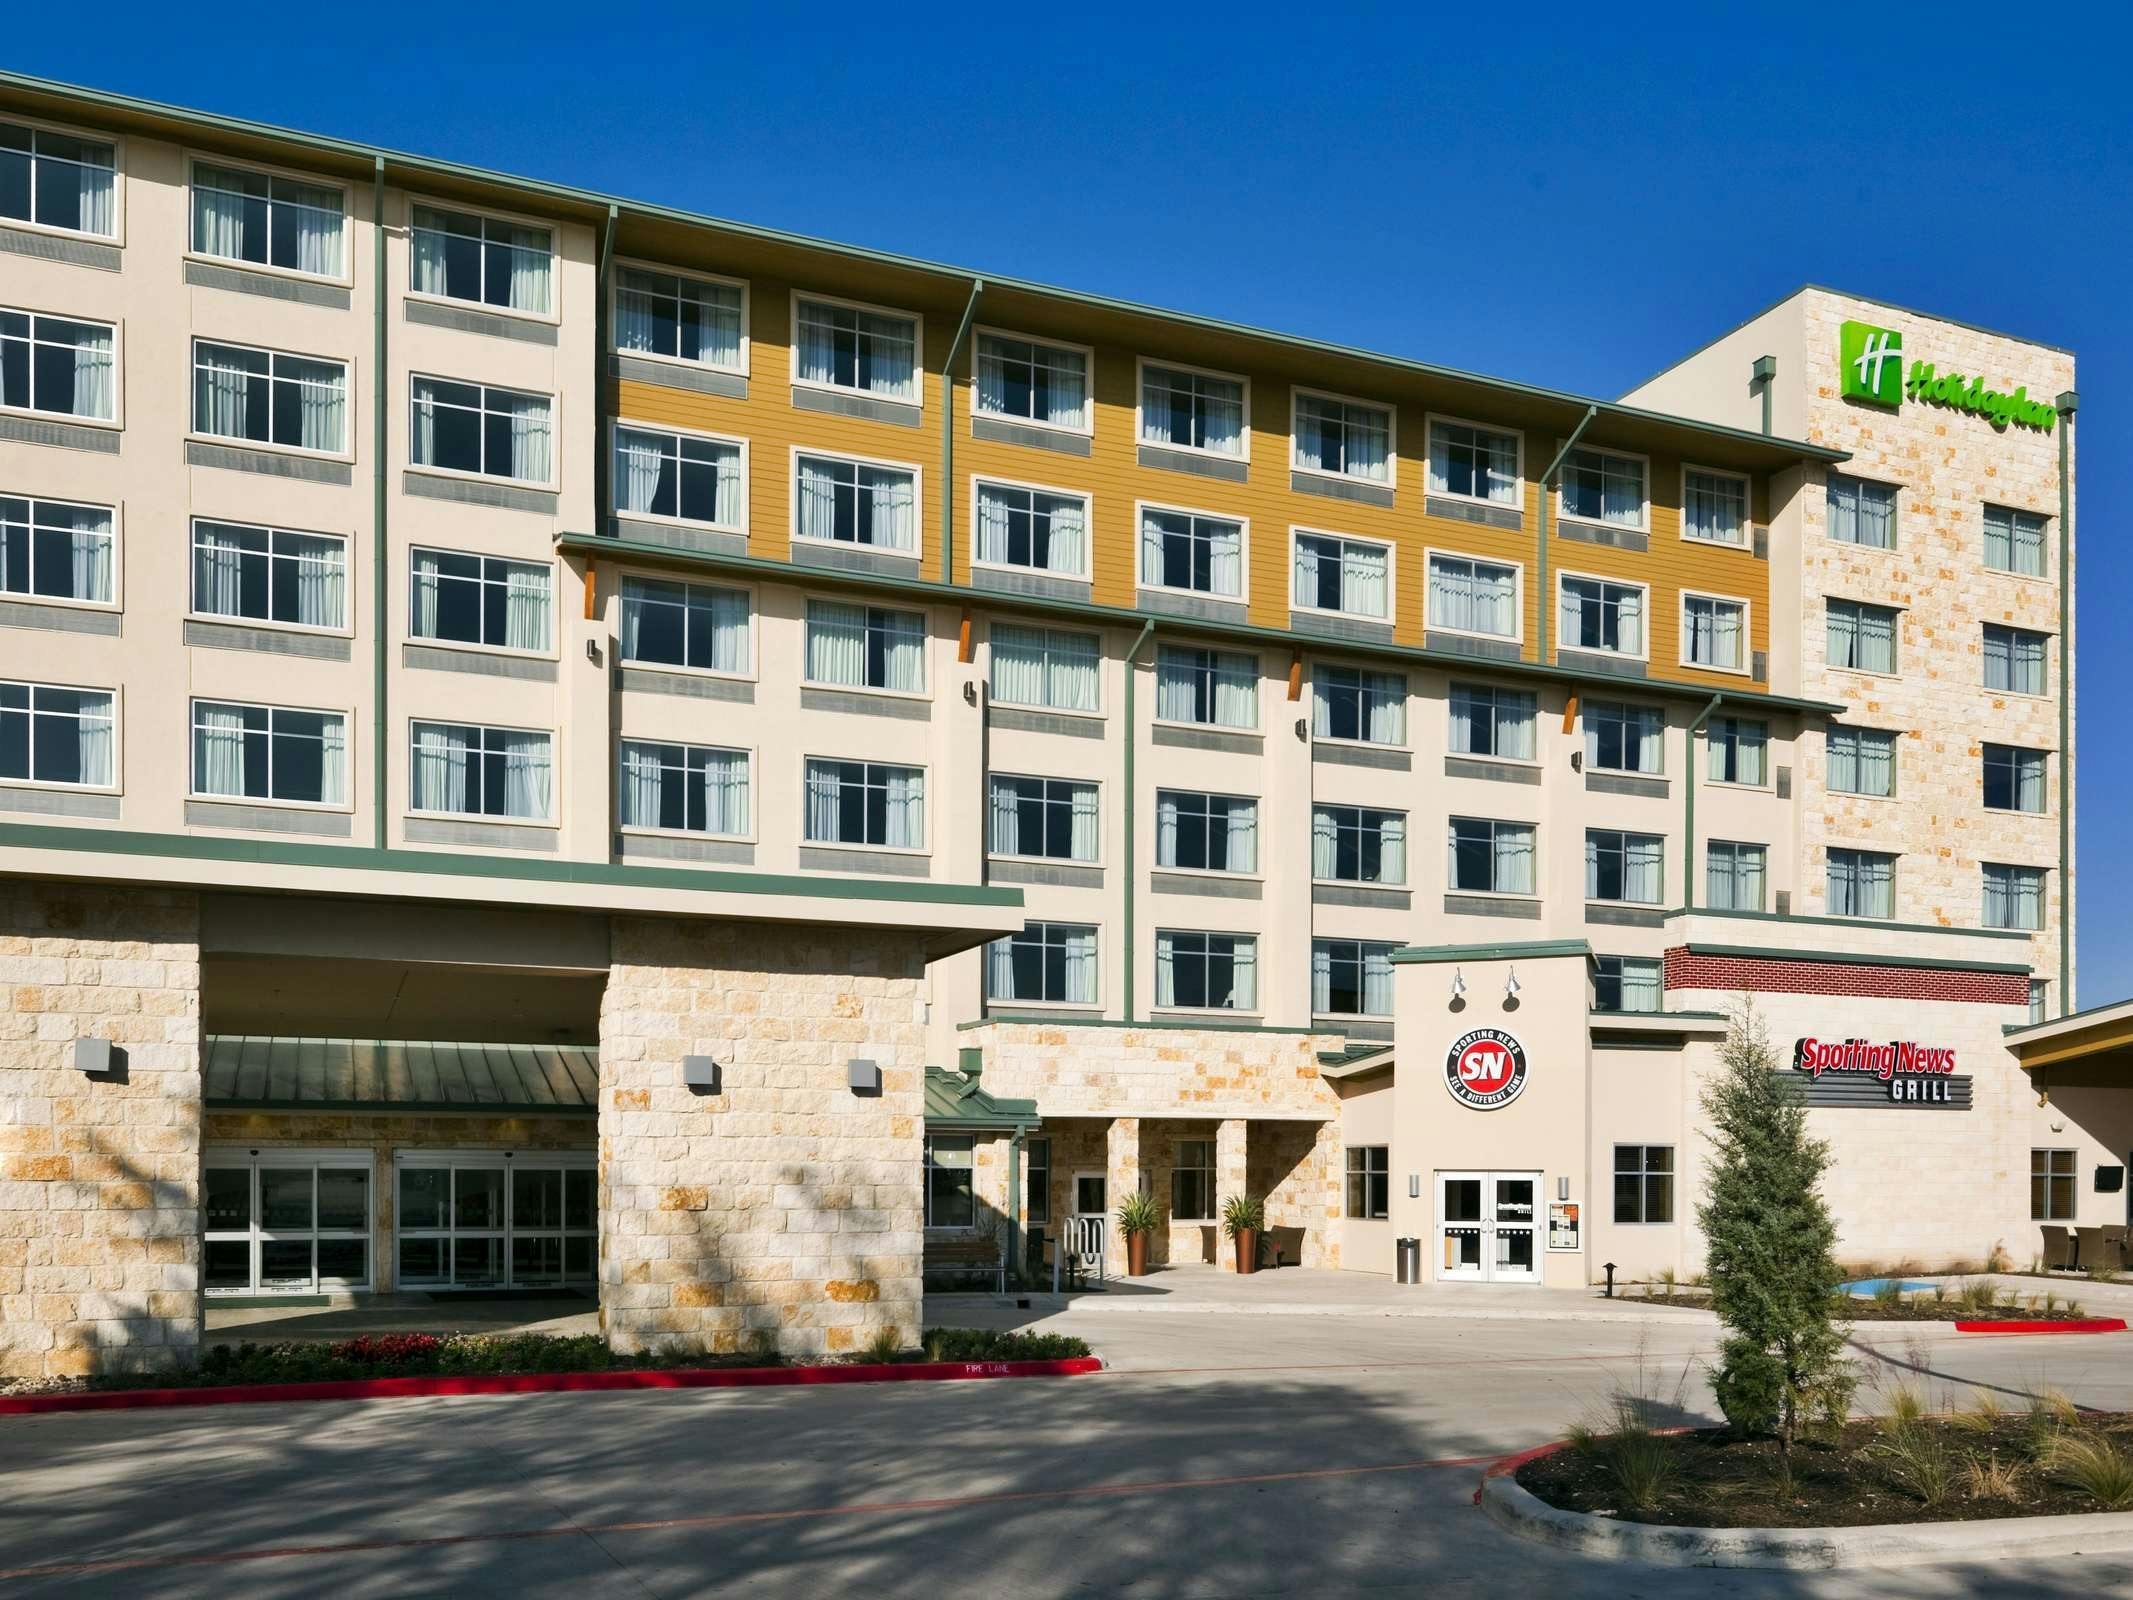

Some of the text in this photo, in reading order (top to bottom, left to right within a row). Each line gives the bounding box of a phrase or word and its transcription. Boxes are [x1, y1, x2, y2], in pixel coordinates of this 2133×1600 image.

[1908, 360, 2011, 427] Holiday
[1452, 1030, 1520, 1057] SPORTING NEWS
[1800, 1036, 1956, 1080] Sporting News
[1462, 1051, 1507, 1080] SN
[1450, 1075, 1462, 1090] SEE
[1466, 1091, 1507, 1104] DIFFERENT
[1506, 1074, 1523, 1093] GAME
[1892, 1079, 1951, 1101] GRILL
[966, 1364, 1009, 1373] FIRE LANE
